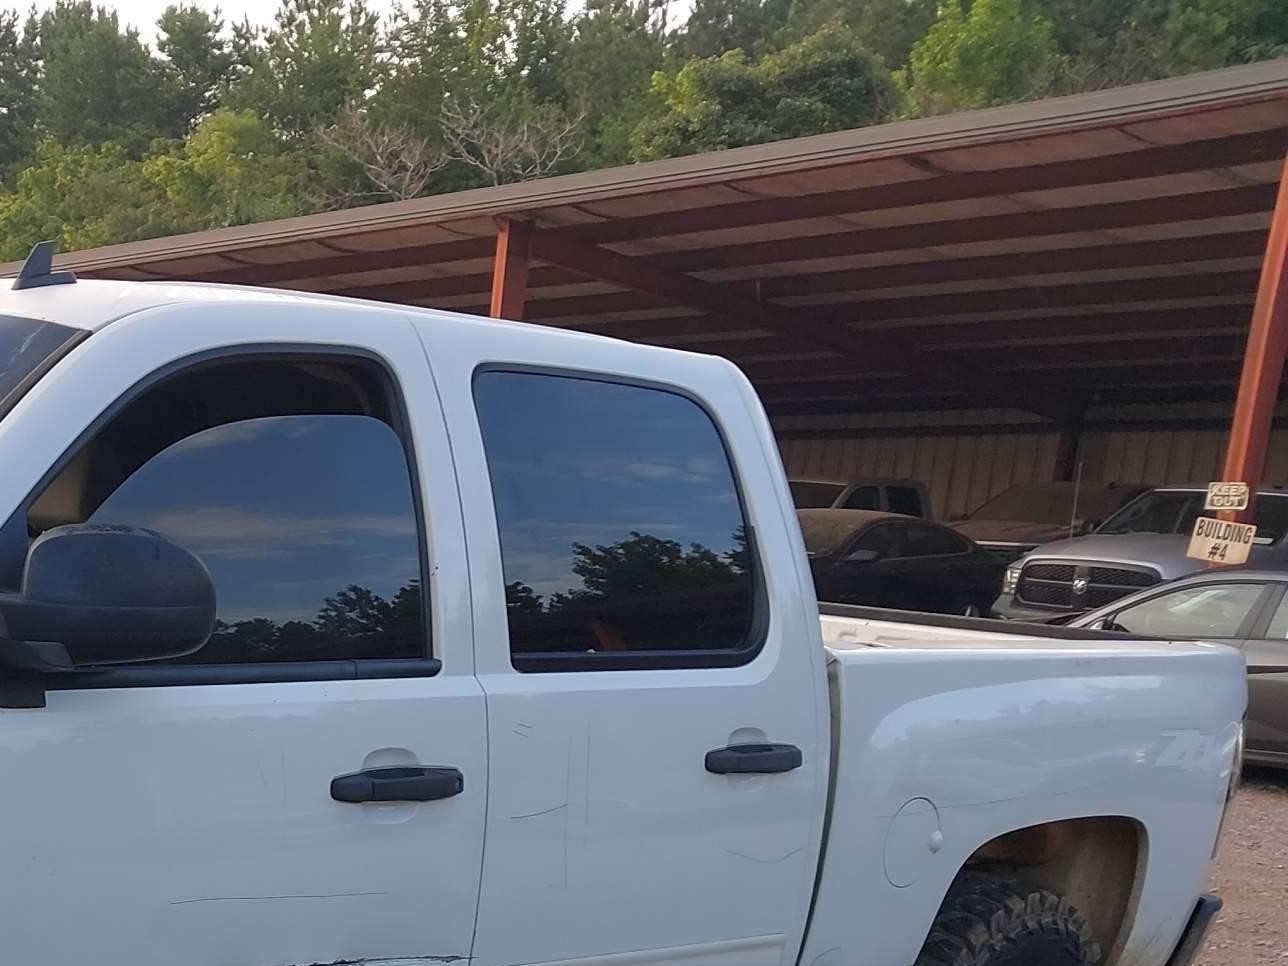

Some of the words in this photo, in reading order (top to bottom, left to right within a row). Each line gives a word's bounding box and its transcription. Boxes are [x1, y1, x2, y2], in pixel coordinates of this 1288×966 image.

[1210, 484, 1246, 496] KEEP
[1214, 496, 1240, 507] OUT
[1195, 519, 1253, 545] BUILDING
[1207, 542, 1229, 561] #4
